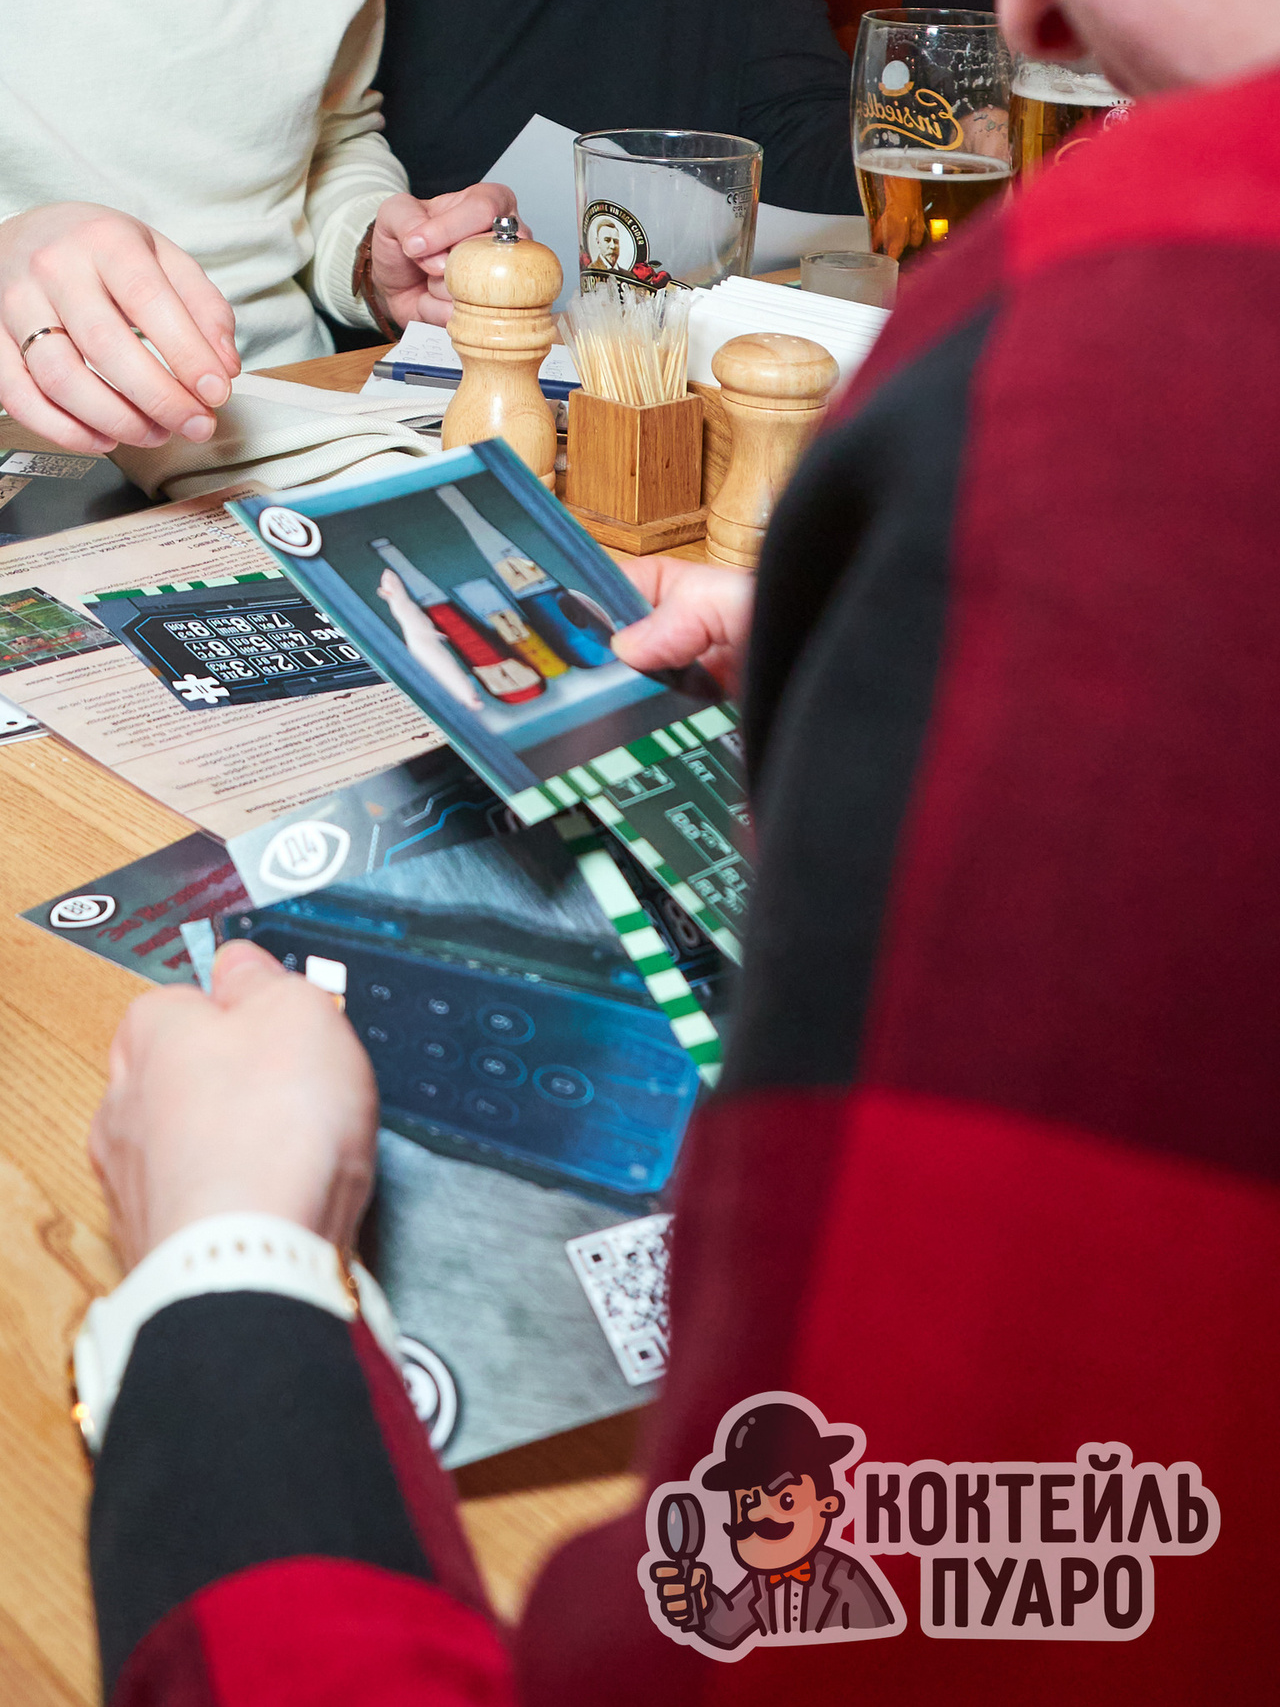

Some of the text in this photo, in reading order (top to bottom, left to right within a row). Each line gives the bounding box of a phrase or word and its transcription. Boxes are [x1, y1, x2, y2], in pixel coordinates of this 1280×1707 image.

[631, 224, 645, 245] CIDER
[187, 621, 211, 637] 9
[208, 641, 232, 656] 6
[231, 660, 254, 677] 3
[270, 655, 295, 671] 2
